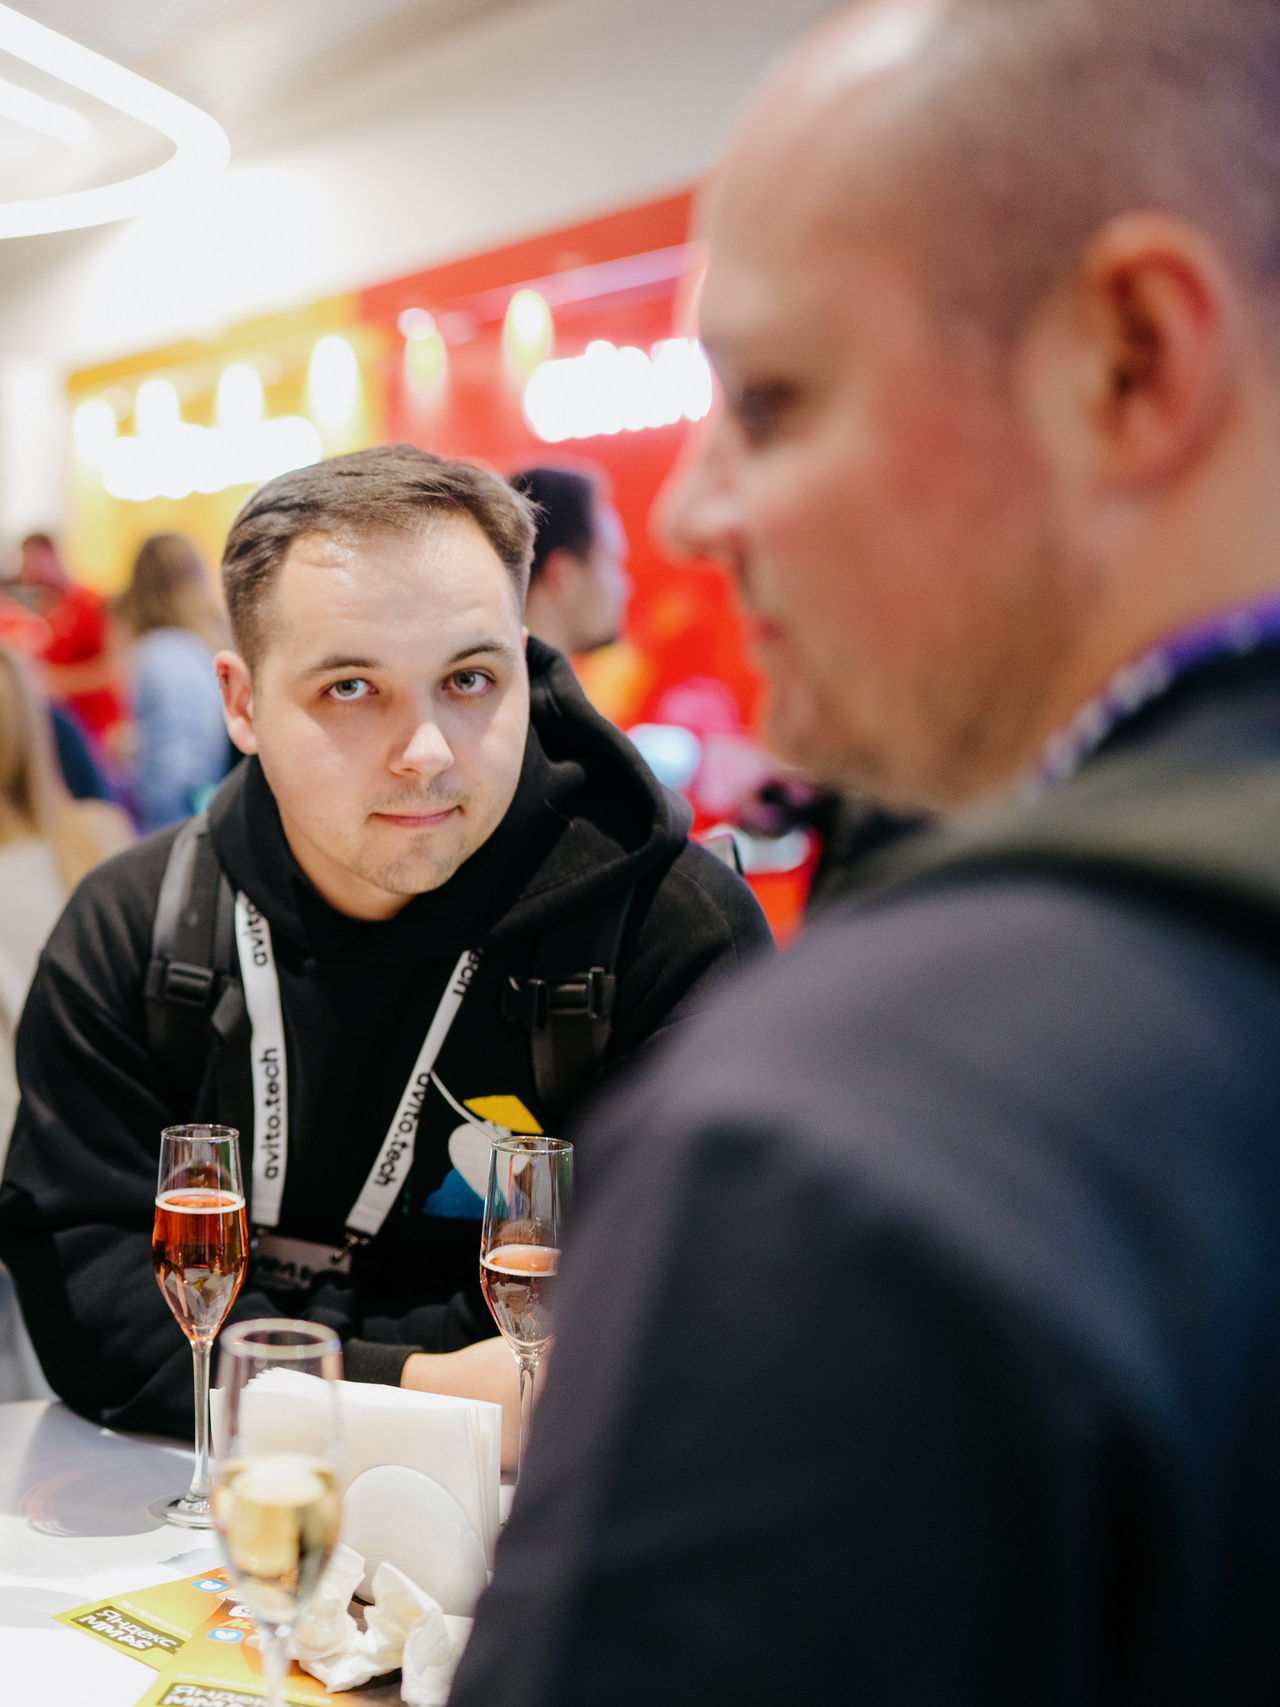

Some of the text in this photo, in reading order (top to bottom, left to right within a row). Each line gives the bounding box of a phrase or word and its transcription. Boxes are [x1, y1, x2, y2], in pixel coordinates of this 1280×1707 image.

[258, 1047, 278, 1180] avito.tech
[373, 1072, 430, 1187] avito.tech
[96, 1609, 178, 1648] Яндекс
